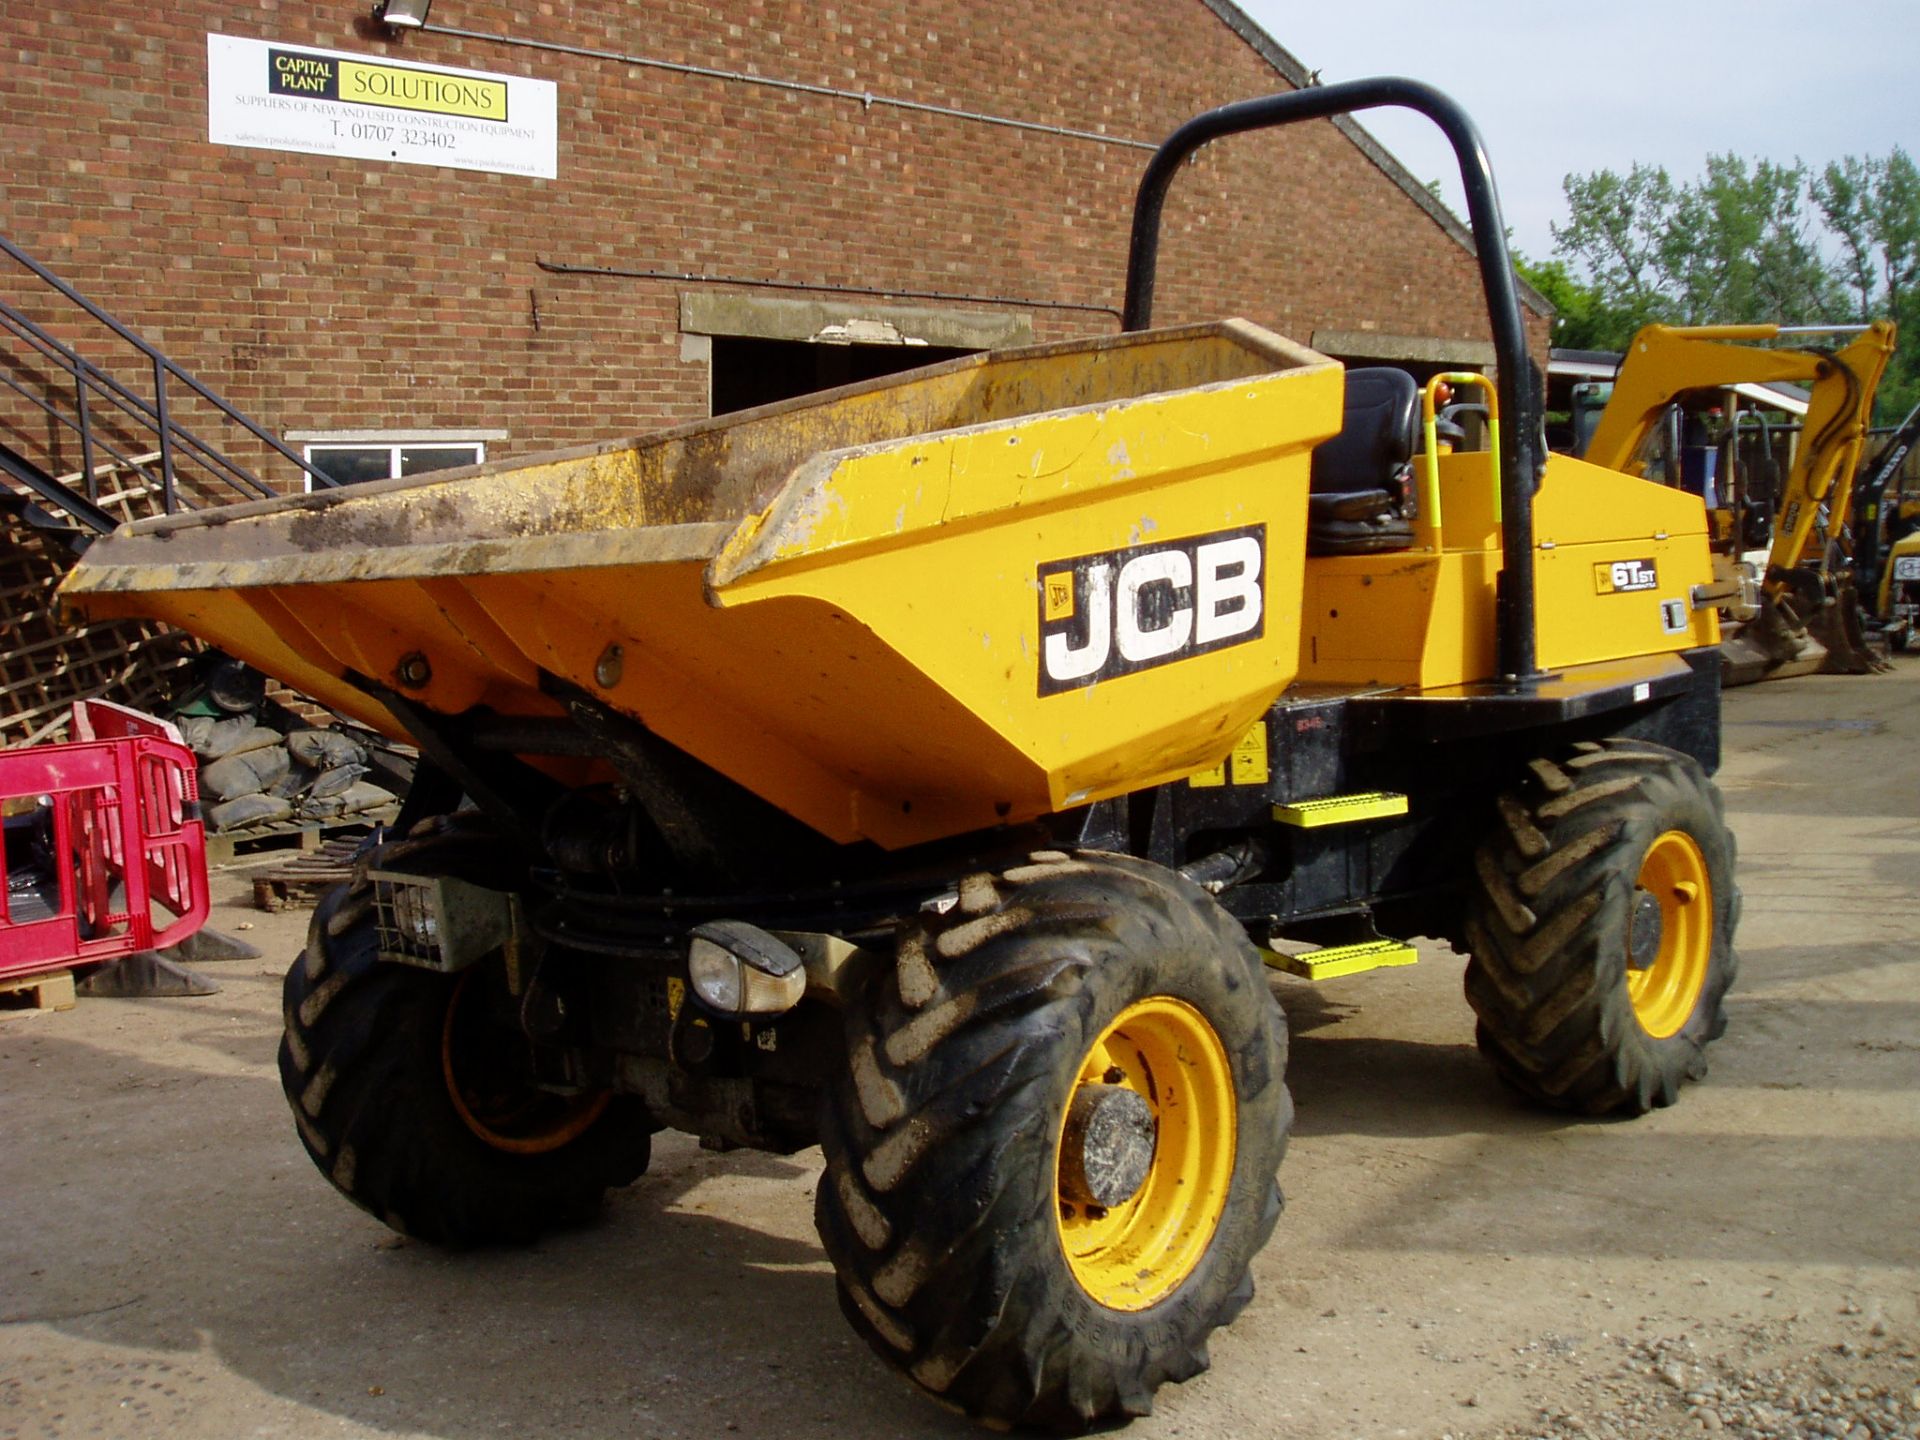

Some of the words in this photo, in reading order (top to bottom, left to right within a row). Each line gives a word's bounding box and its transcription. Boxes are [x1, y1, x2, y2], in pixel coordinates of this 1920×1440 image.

[275, 56, 332, 78] CAPITAL
[281, 75, 328, 93] PLANT
[354, 70, 493, 109] SOLUTIONS
[235, 94, 291, 111] SUPPLIERS
[294, 101, 309, 113] OF
[312, 103, 338, 117] NEW
[341, 107, 365, 119] AND
[367, 109, 396, 122] USED
[398, 114, 480, 133] CONSTRUCTION
[481, 124, 536, 140] EQUIPMENT
[330, 119, 345, 137] T.
[351, 122, 395, 143] 01707
[401, 128, 456, 149] 323402
[1871, 445, 1909, 487] VOLVO
[1044, 536, 1262, 681] JCB
[1051, 584, 1069, 607] JCB
